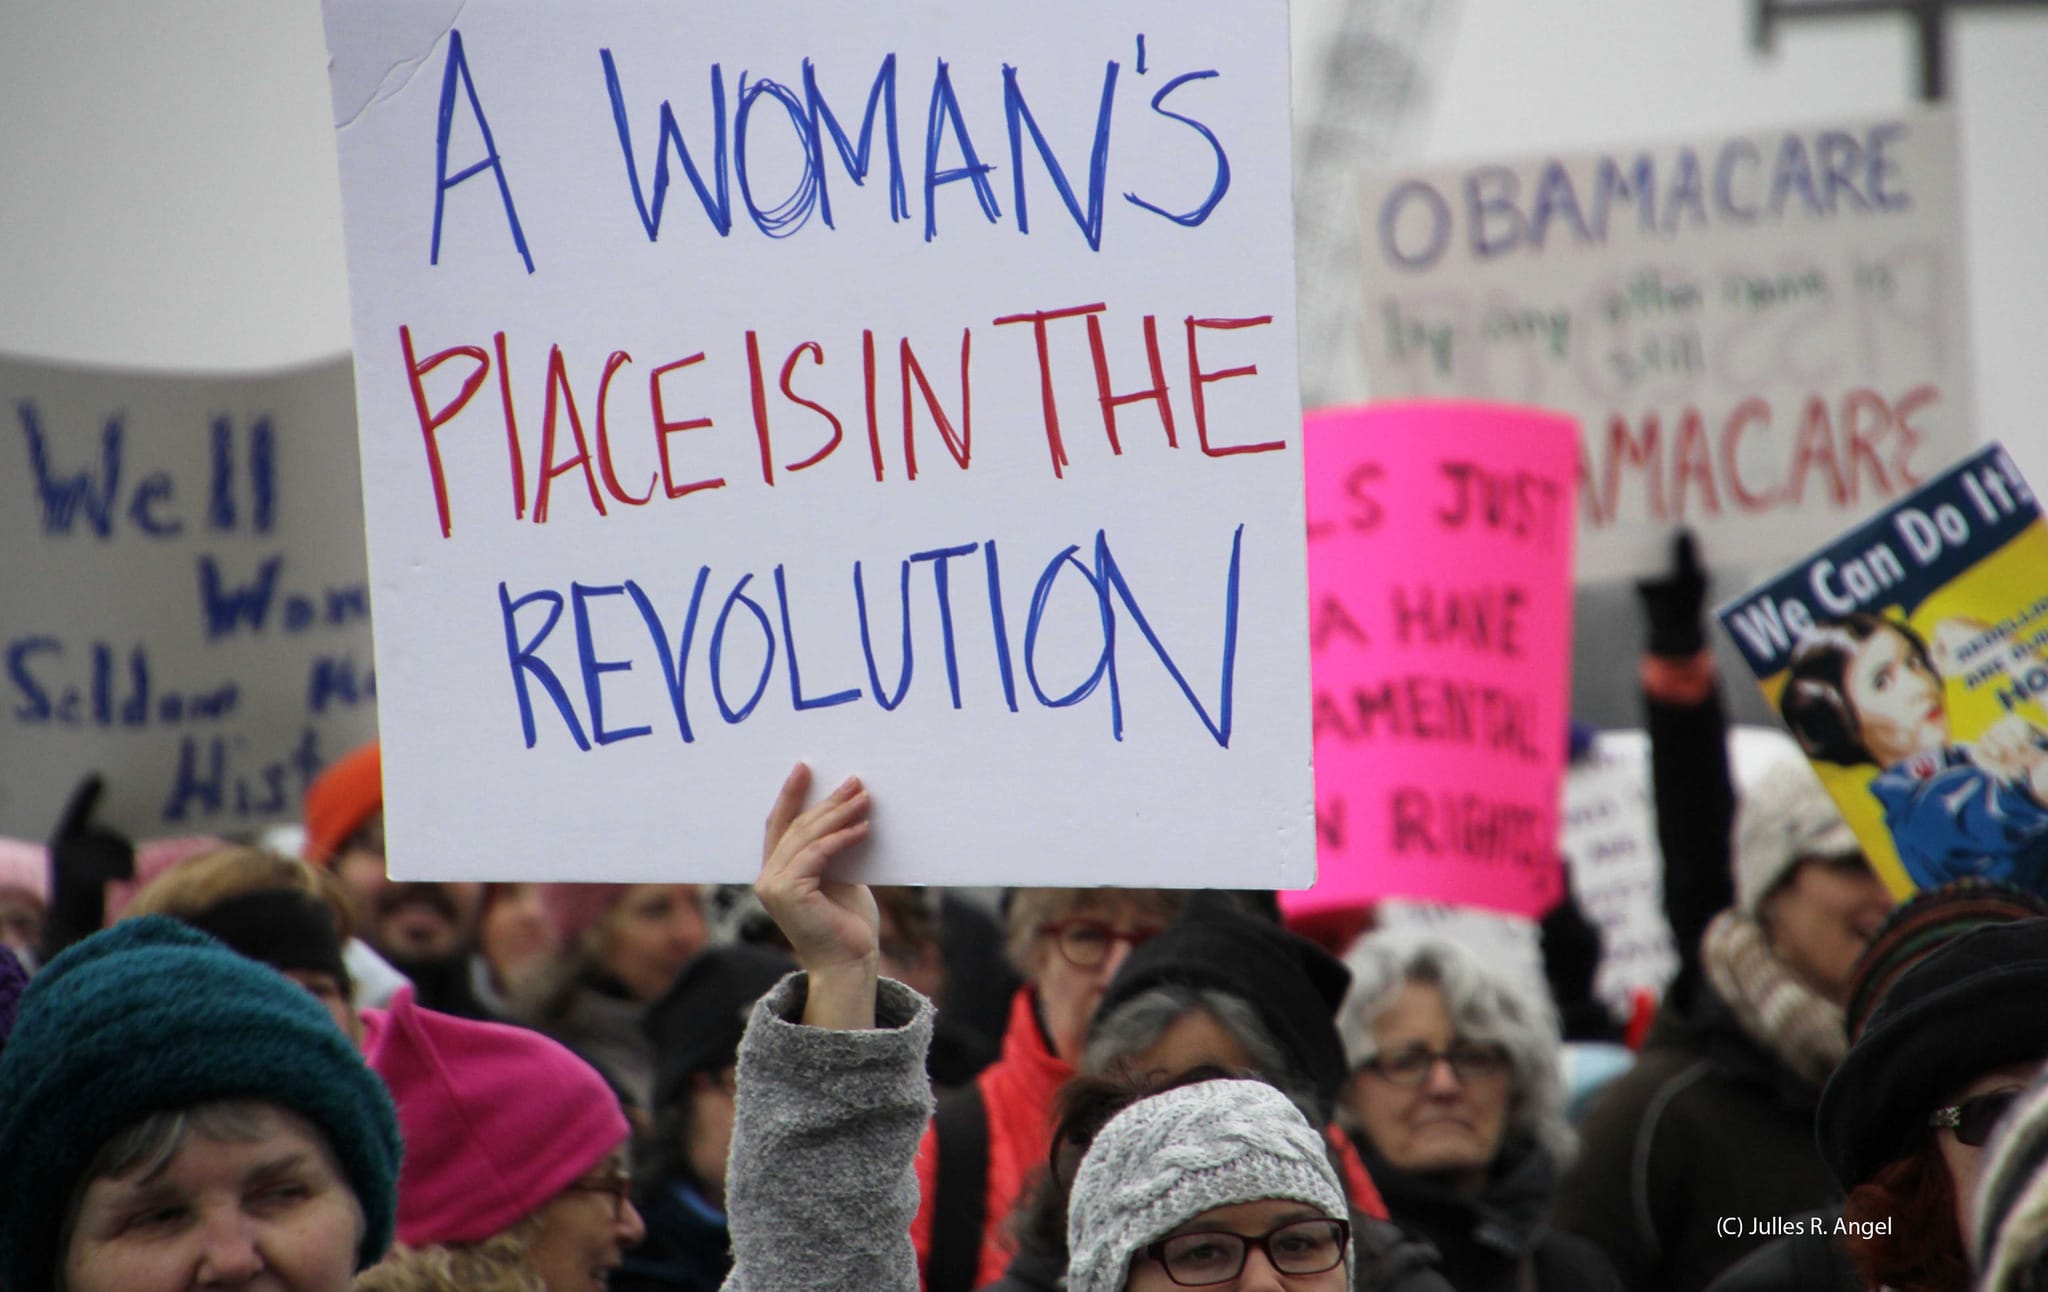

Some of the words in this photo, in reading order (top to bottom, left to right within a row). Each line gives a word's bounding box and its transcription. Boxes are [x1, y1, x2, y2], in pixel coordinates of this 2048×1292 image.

[431, 29, 534, 273] A
[599, 33, 1230, 252] WOMAN'S
[1378, 122, 1910, 270] OBAMACARE
[17, 397, 276, 540] Well
[746, 331, 842, 485] IS
[864, 329, 970, 481] IN
[994, 303, 1286, 478] THE
[1437, 458, 1562, 552] JUST
[1732, 594, 1818, 662] We
[1809, 556, 1907, 619] Can
[1894, 503, 1970, 565] Do
[1962, 448, 2036, 526] It!
[498, 525, 1243, 752] REVOLUTION
[1390, 586, 1526, 658] HAVE
